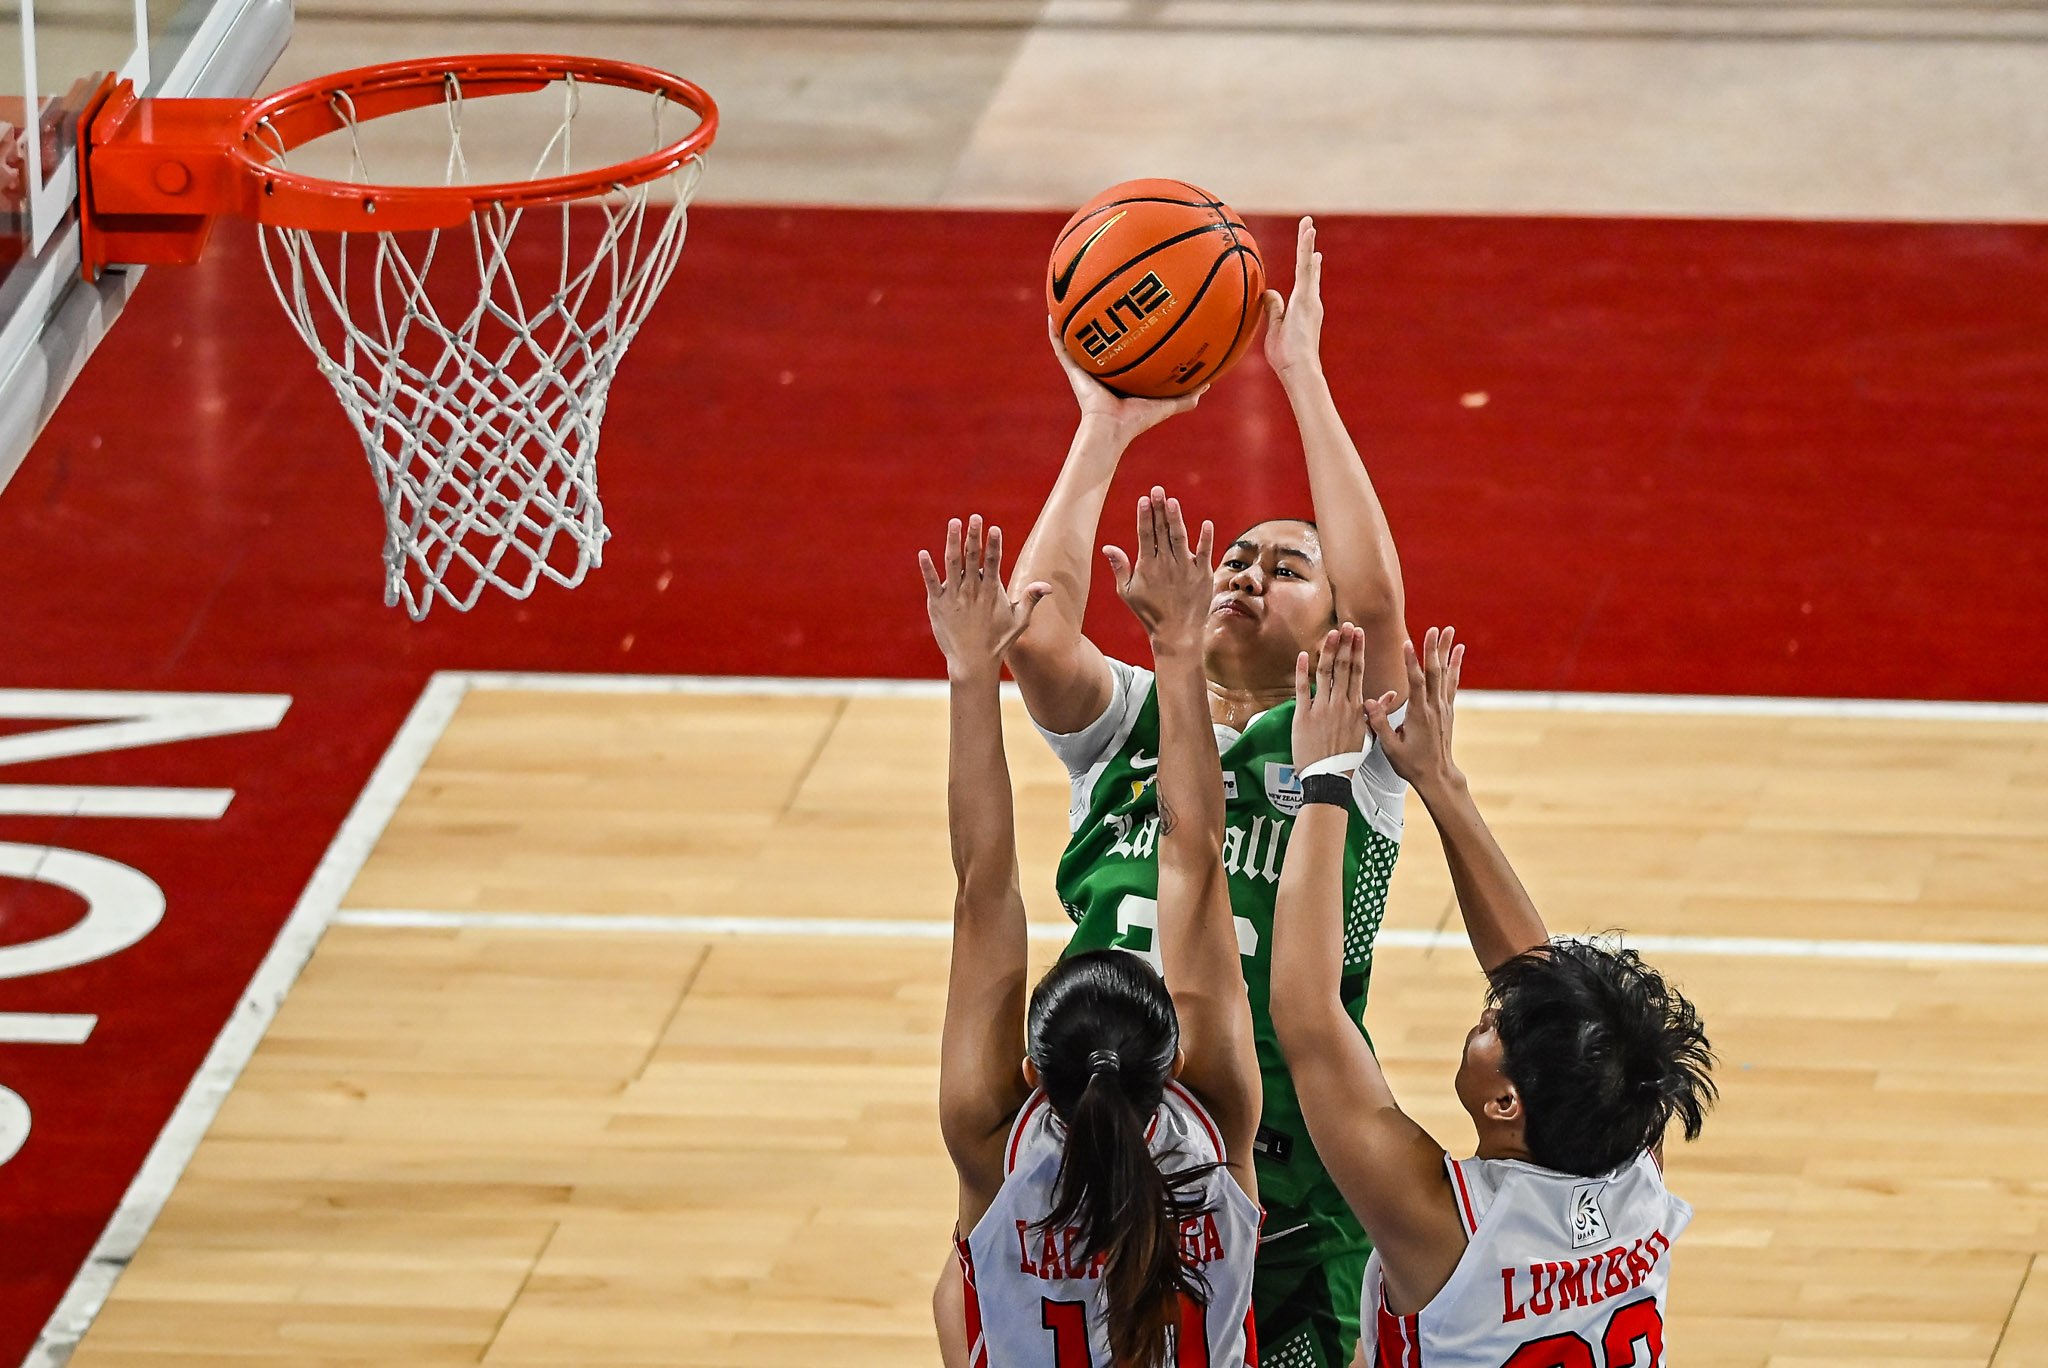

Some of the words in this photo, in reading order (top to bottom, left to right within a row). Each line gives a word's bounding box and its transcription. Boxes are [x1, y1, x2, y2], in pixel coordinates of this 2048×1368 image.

[1282, 793, 1303, 802] ZEALA
[1222, 815, 1288, 884] all
[1577, 1229, 1596, 1241] UAAP
